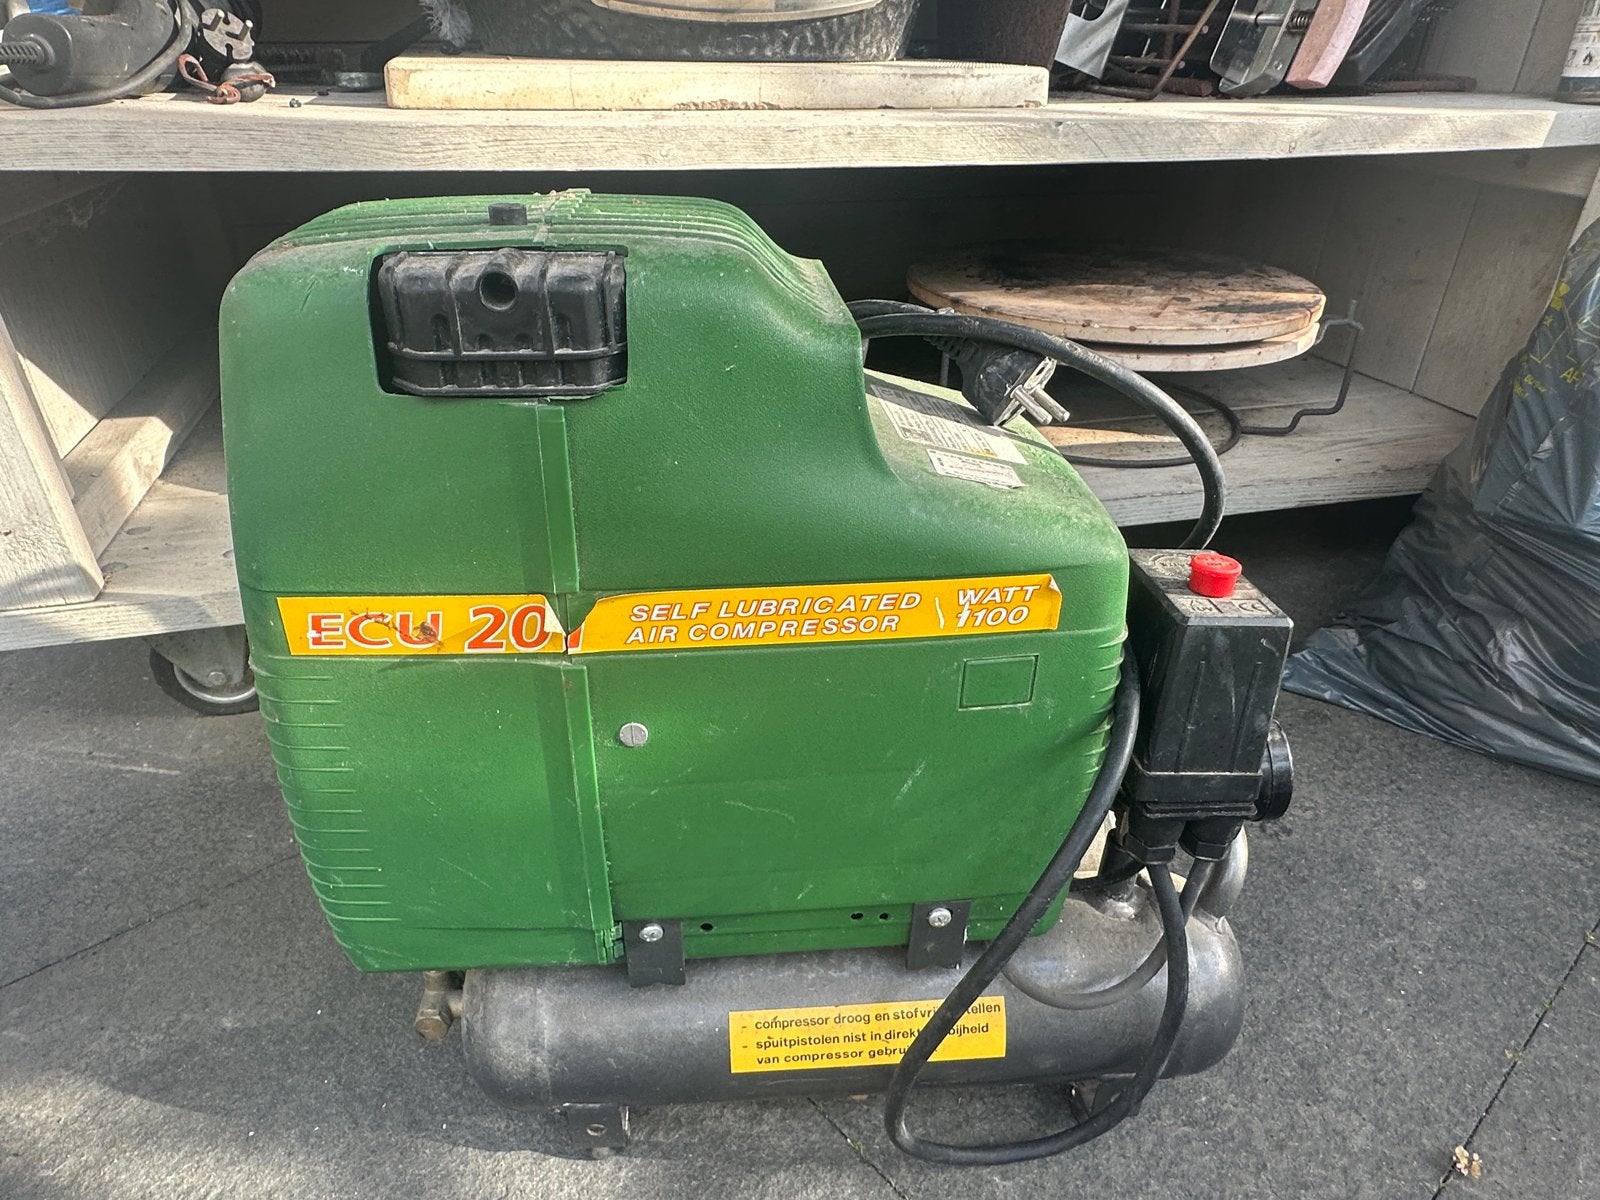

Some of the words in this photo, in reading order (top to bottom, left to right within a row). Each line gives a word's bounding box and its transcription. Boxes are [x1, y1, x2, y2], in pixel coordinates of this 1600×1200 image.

[629, 600, 711, 622] SELF
[717, 591, 923, 619] LUBRICATED
[957, 583, 1042, 606] WATT
[956, 605, 1030, 628] 1100
[307, 611, 443, 649] ECU
[625, 623, 678, 645] AIR
[688, 614, 901, 641] COMPRESSOR
[755, 1015, 830, 1031] compressor
[833, 1013, 871, 1025] droog
[875, 1012, 890, 1022] en
[966, 1003, 1001, 1014] ellen
[756, 1034, 840, 1050] spuitpistolen
[843, 1032, 867, 1043] nist
[870, 1031, 881, 1041] in
[757, 1055, 780, 1065] van
[784, 1050, 864, 1063] compressor
[868, 1045, 910, 1059] gebru
